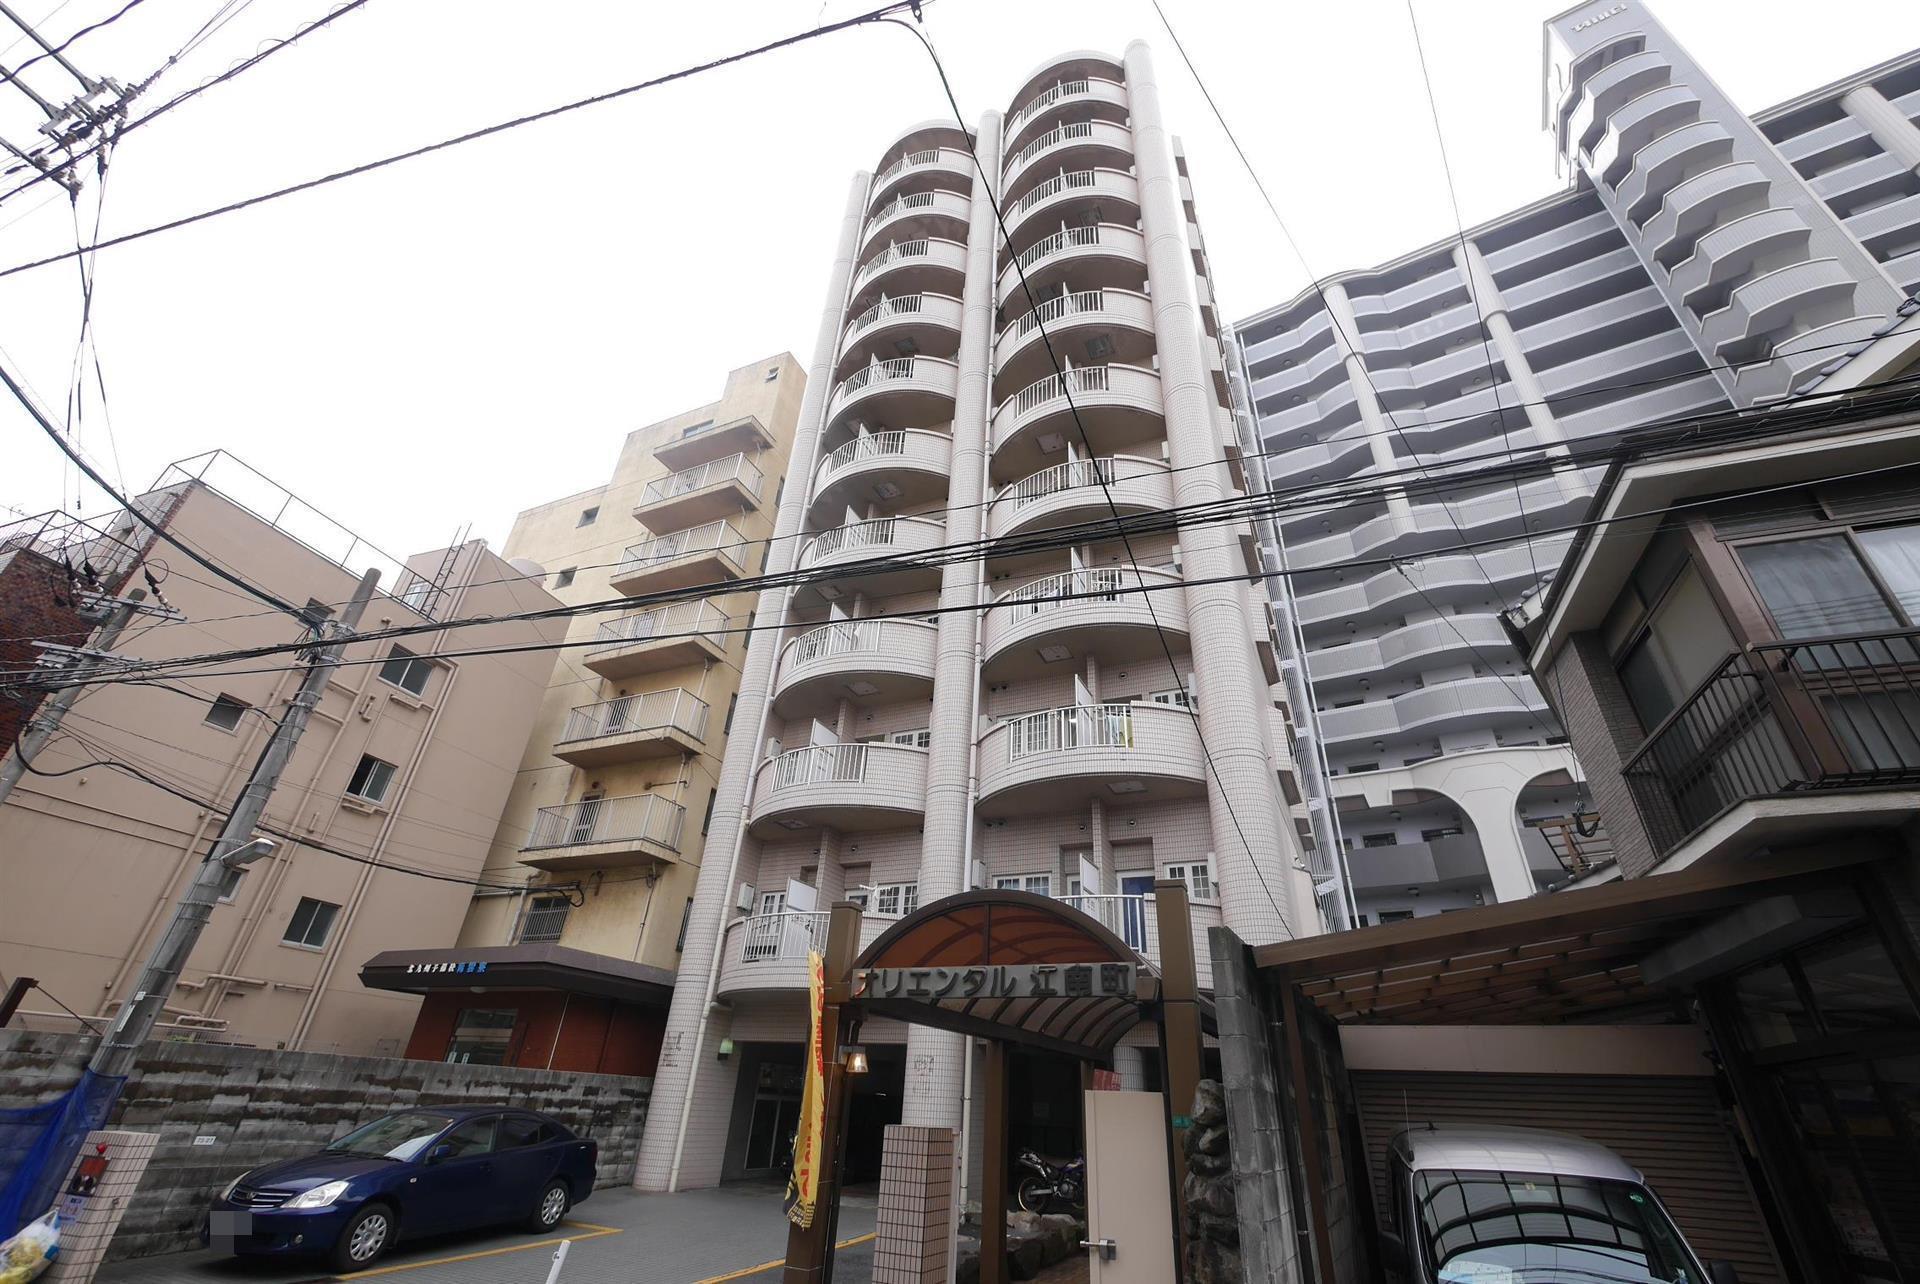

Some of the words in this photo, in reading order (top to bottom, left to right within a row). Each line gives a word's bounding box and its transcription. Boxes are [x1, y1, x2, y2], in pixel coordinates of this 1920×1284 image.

[854, 965, 1018, 998] オリエンタル
[1029, 963, 1130, 997] 江南町
